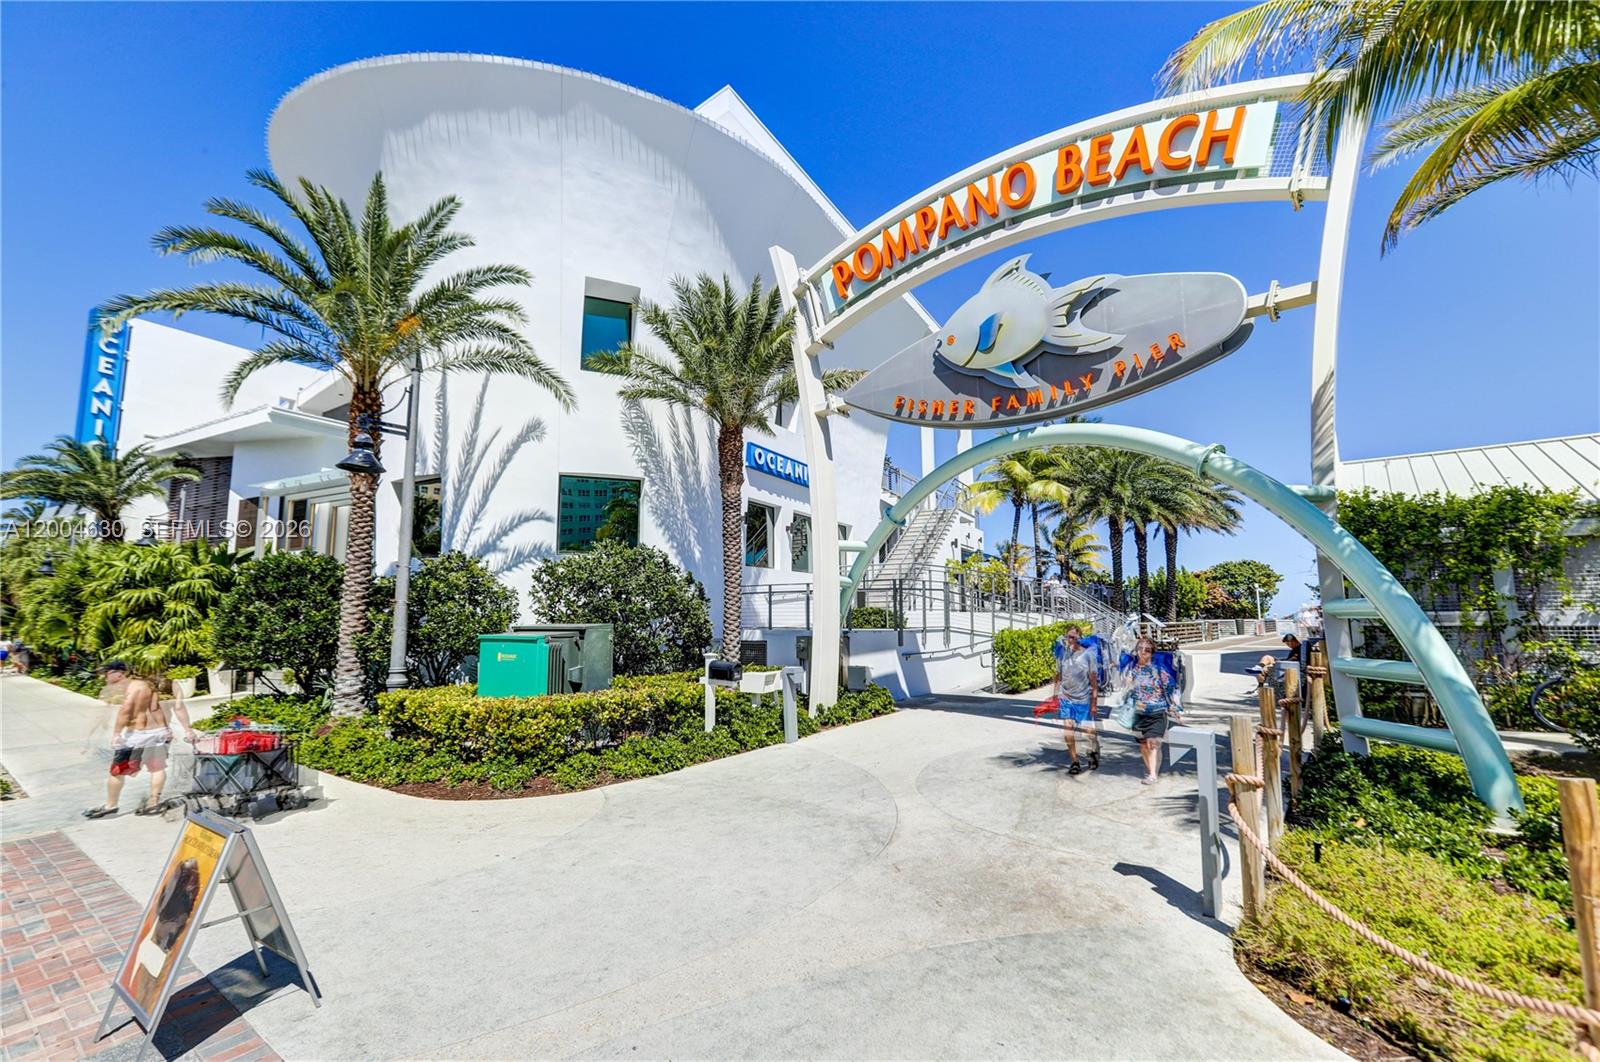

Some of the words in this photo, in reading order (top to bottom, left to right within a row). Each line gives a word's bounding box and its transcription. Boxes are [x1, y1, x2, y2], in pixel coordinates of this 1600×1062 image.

[831, 161, 1036, 300] POMPANO
[1055, 106, 1247, 195] BEACH
[892, 394, 976, 415] FISHER
[991, 372, 1093, 412] FAMILY
[1113, 331, 1186, 377] PIER
